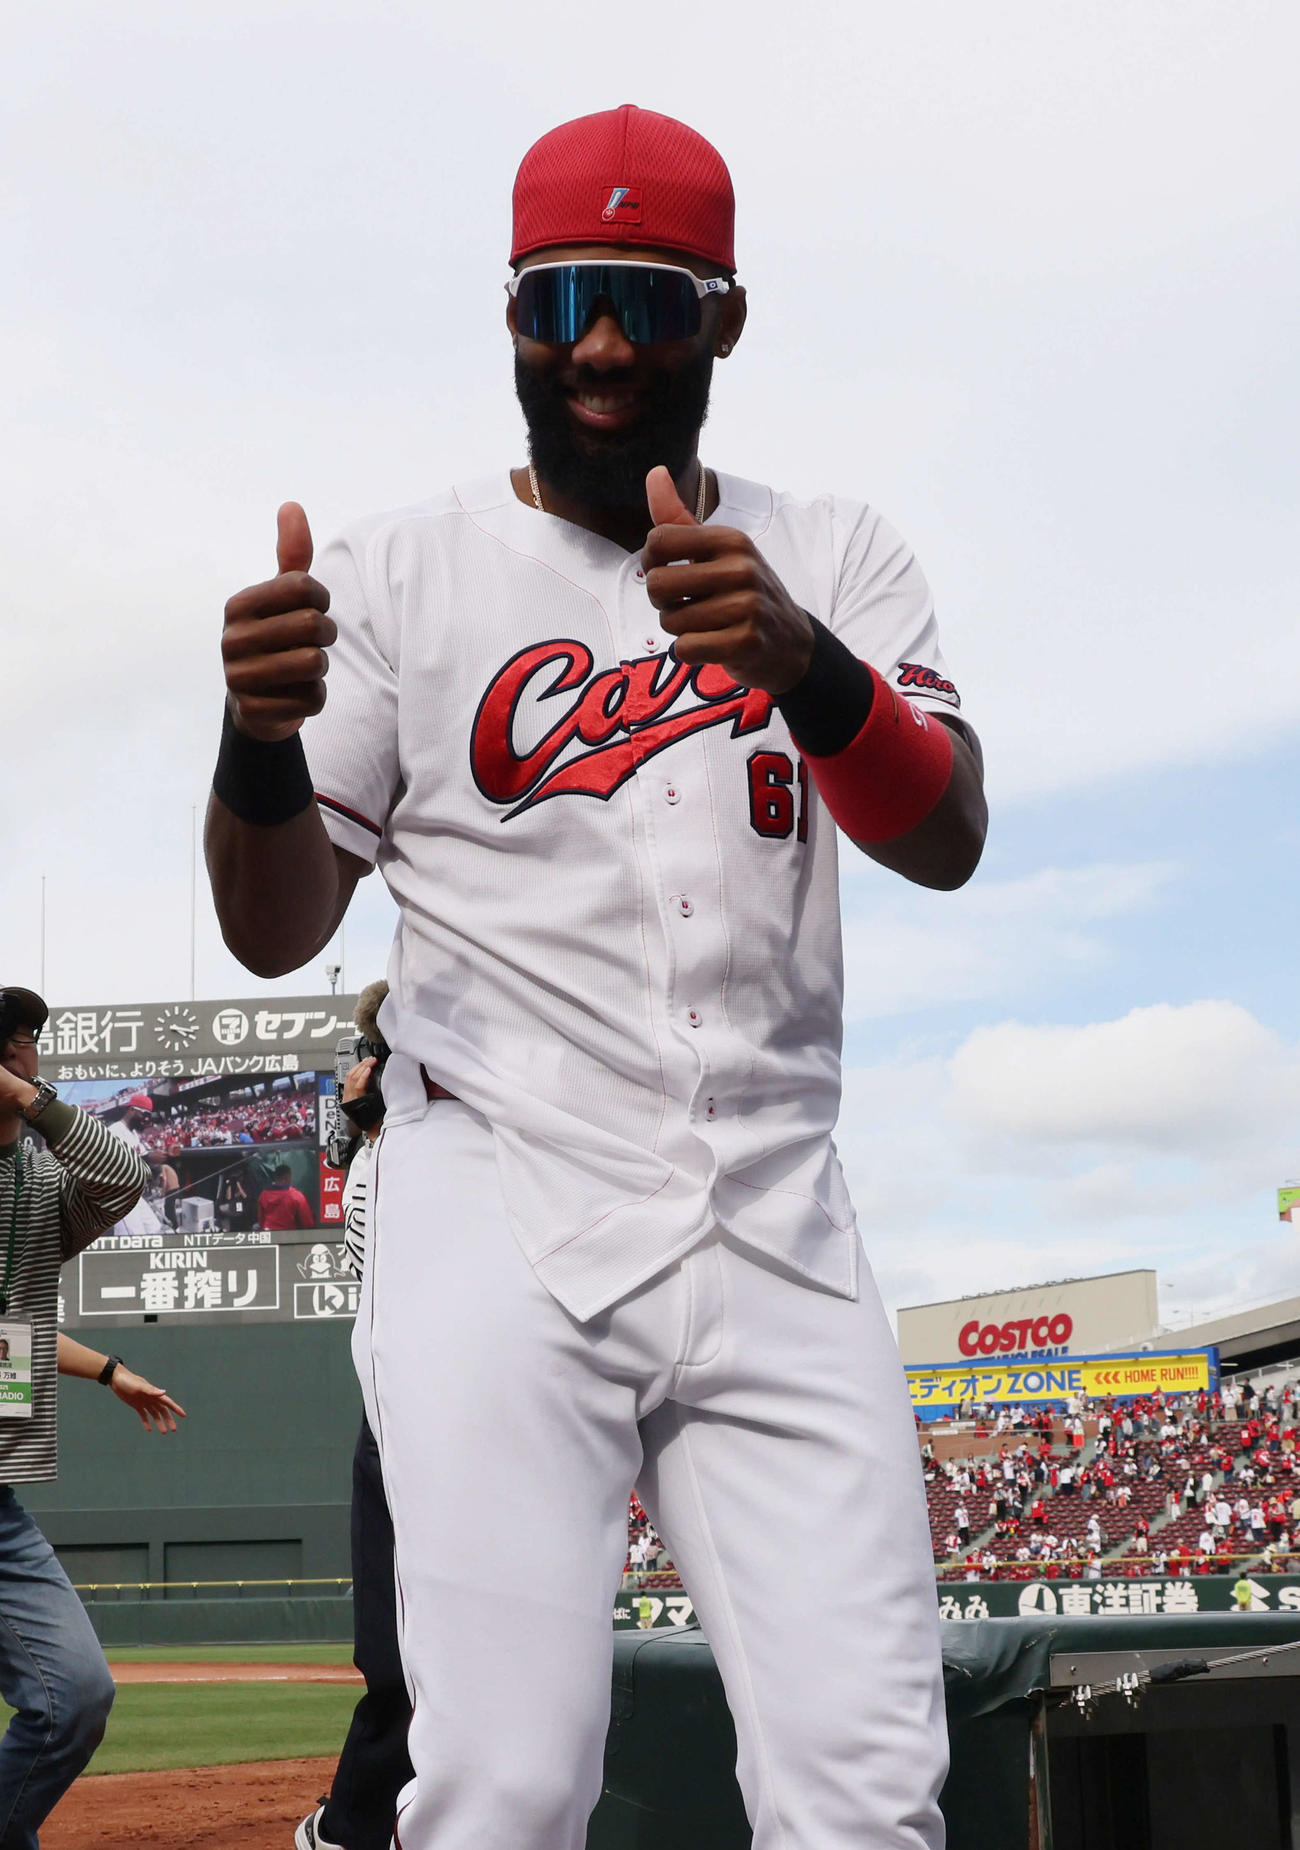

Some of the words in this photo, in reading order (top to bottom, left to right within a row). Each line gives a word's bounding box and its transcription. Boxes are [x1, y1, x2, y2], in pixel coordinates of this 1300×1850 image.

[190, 1054, 299, 1076] JAバンク広島
[324, 1176, 341, 1219] 広島
[150, 1251, 207, 1269] KIRIN
[101, 1269, 257, 1310] 一番搾り
[958, 1313, 1073, 1357] COSTCO
[1007, 1369, 1082, 1395] ZONE
[1125, 1369, 1157, 1383] HOME
[1058, 1582, 1199, 1614] 東洋証券
